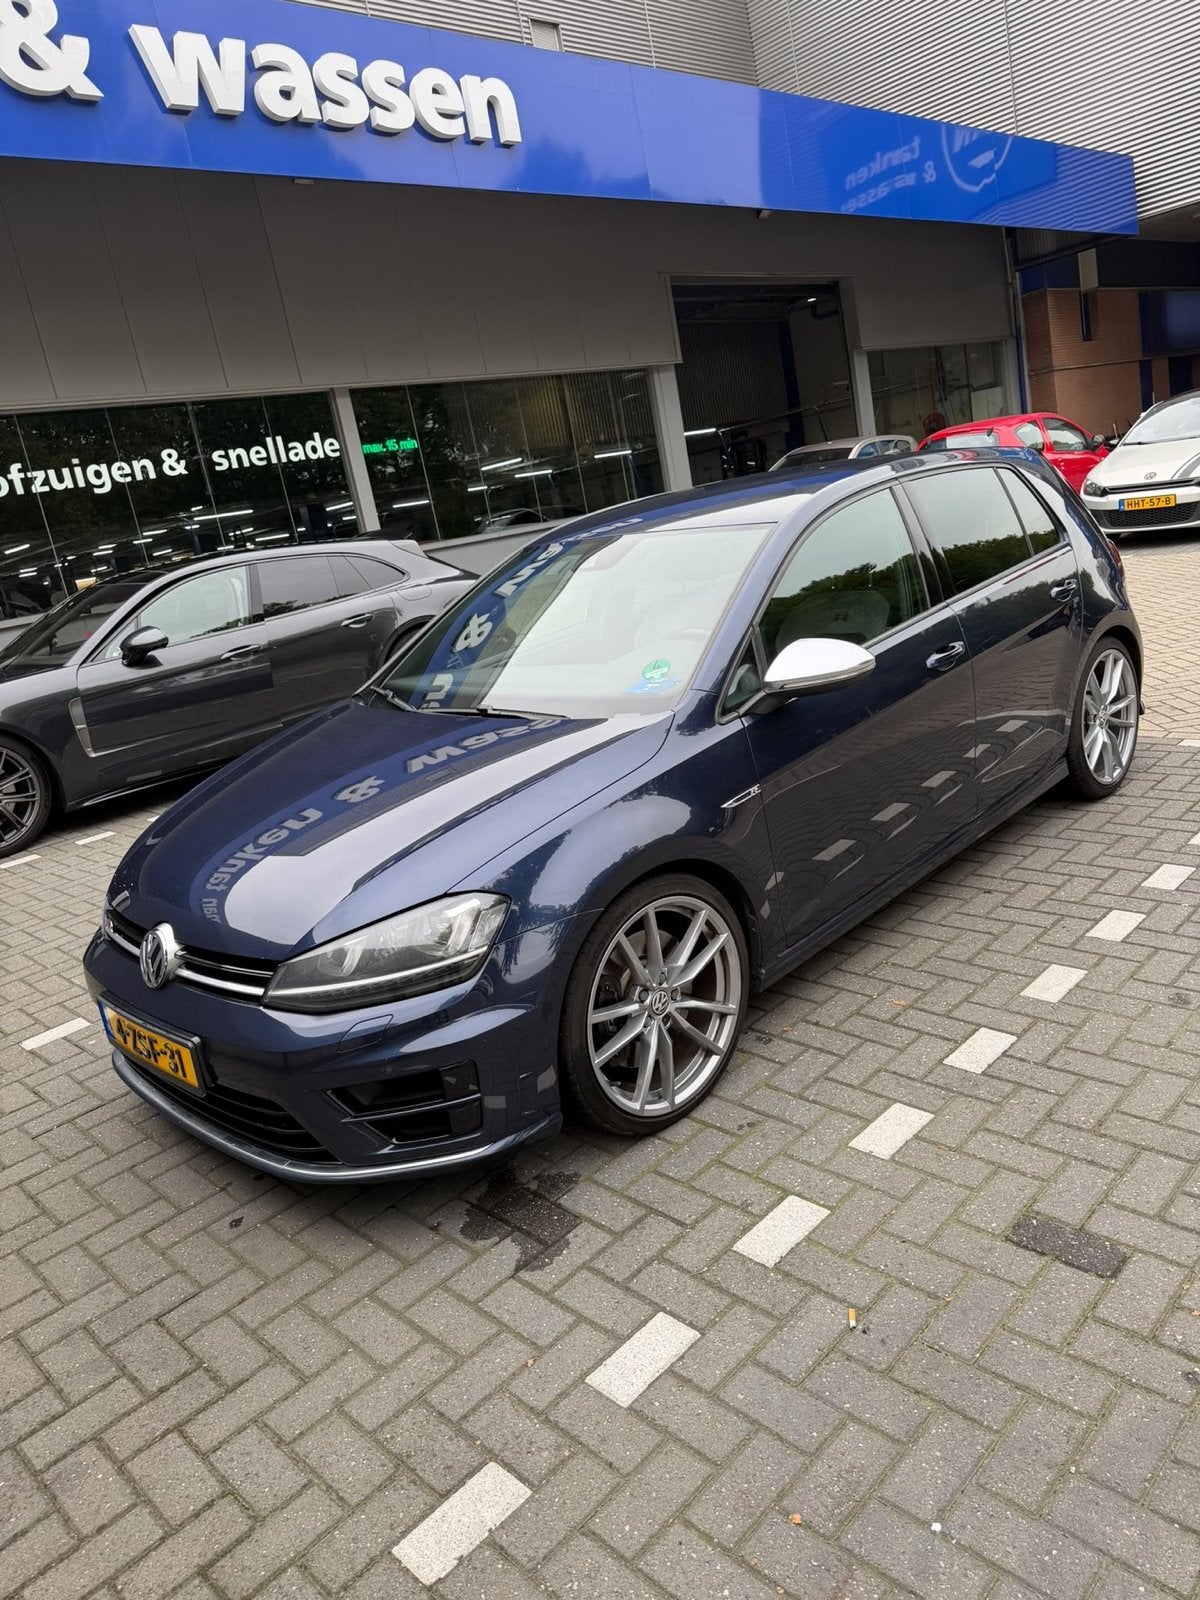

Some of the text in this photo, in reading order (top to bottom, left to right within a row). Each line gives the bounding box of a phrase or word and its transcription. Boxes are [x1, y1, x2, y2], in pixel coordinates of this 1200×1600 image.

[0, 0, 523, 145] & wassen
[160, 448, 189, 476] &
[211, 432, 341, 471] snellade
[399, 437, 418, 450] min
[1126, 496, 1171, 509] HHT-57-B
